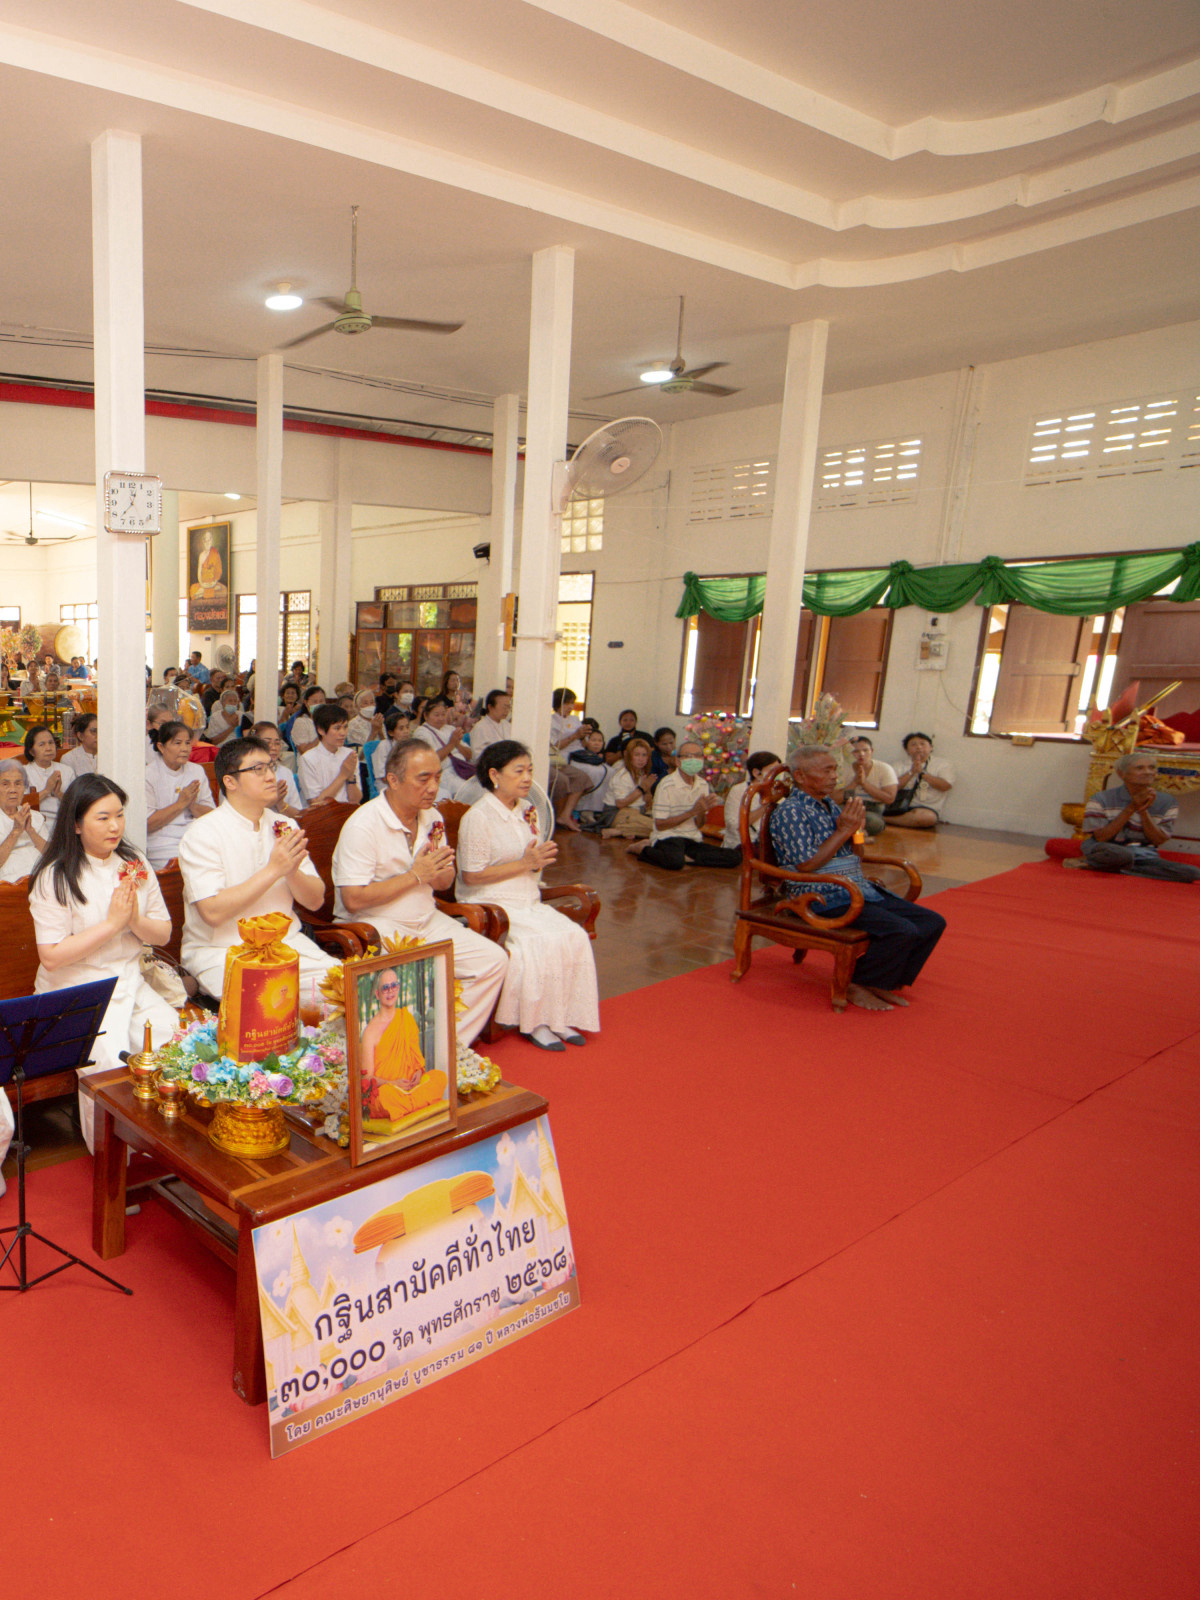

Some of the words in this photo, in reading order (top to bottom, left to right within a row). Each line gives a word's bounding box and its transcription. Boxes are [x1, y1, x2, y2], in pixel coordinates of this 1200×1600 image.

[280, 1340, 386, 1403] ๓๐,๐๐๐
[392, 1327, 415, 1351] วัด
[418, 1287, 501, 1345] พุทธศักราช
[505, 1246, 568, 1294] ๒๕๖๘
[314, 1218, 536, 1344] กฐินสามัคคีทั่วไทย
[285, 1421, 311, 1441] โดย
[315, 1371, 409, 1427] คณะศิษยานุศิษย์
[413, 1347, 465, 1385] บูชาธรรม
[467, 1340, 483, 1355] ๘๑
[486, 1329, 494, 1345] ปี
